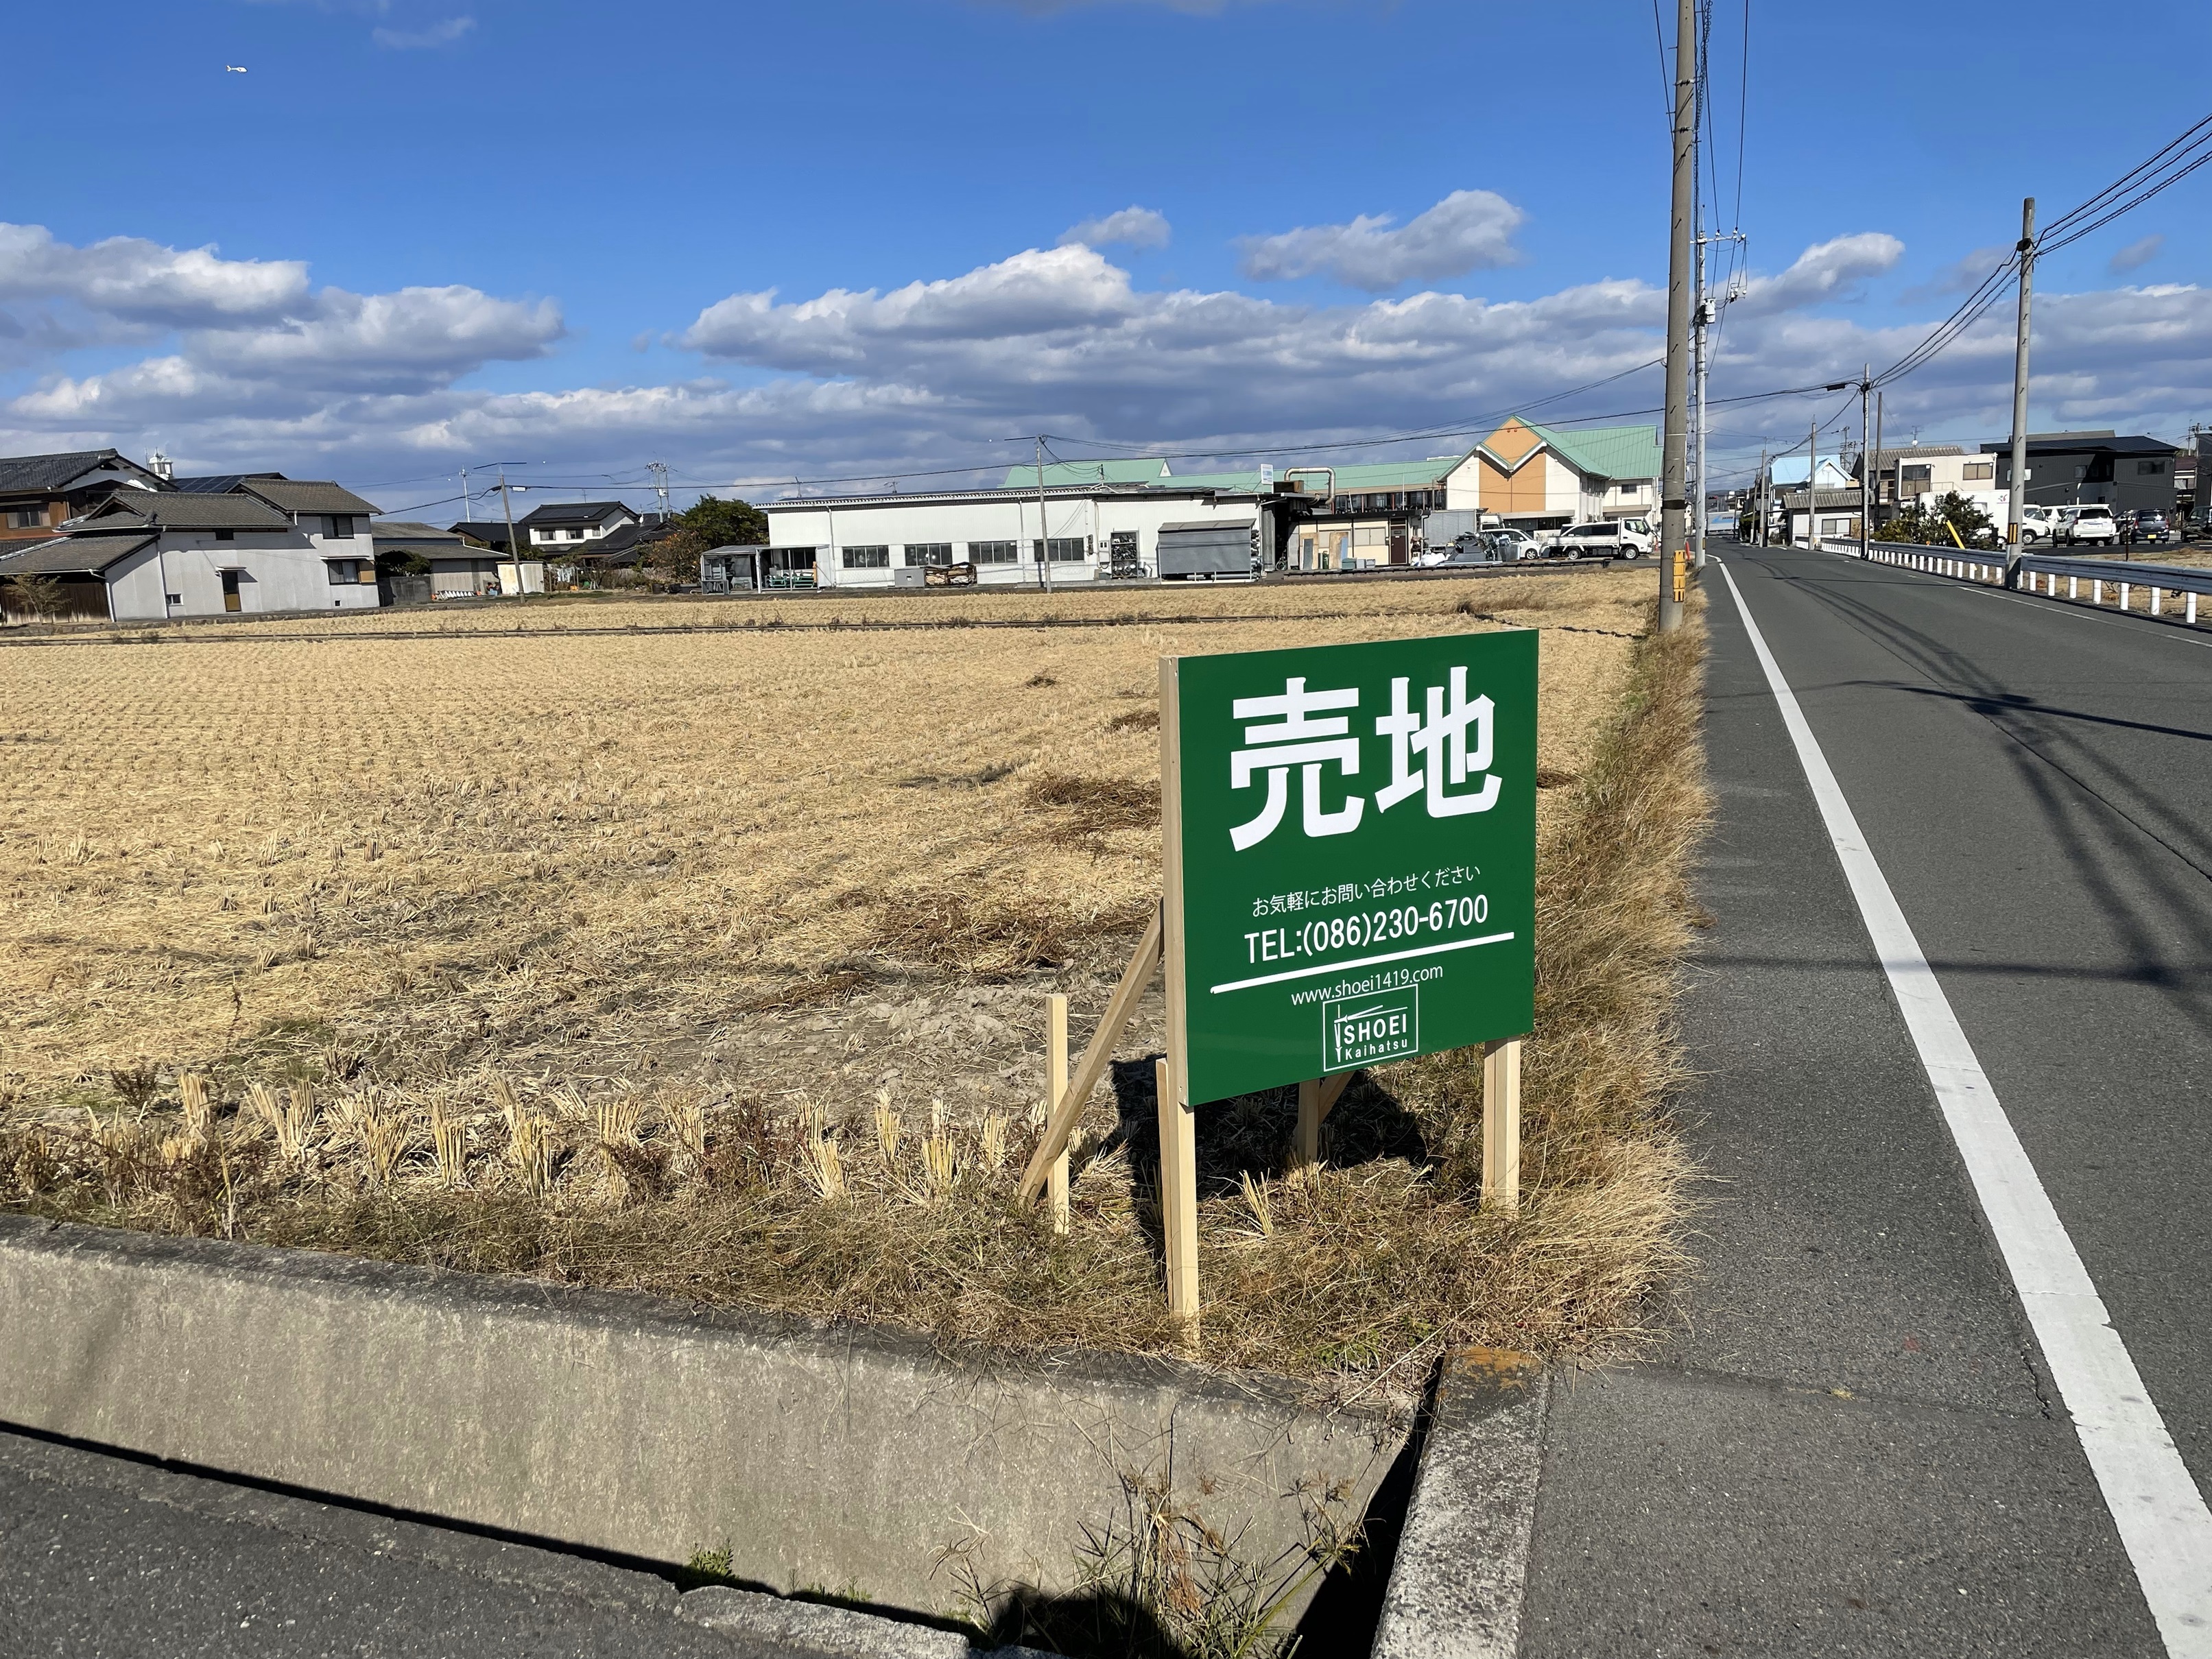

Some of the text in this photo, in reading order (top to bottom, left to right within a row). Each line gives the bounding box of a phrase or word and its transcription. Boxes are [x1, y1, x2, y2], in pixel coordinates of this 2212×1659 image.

[1229, 666, 1502, 852] 売地
[1252, 866, 1481, 918] お気軽にお問い合わせください
[1244, 894, 1488, 964] TEL:(086)230-6700
[1291, 966, 1443, 1006] www.shoei1419.com
[1344, 1013, 1407, 1045] SHOEI
[1345, 1038, 1407, 1061] Kaihatsu
